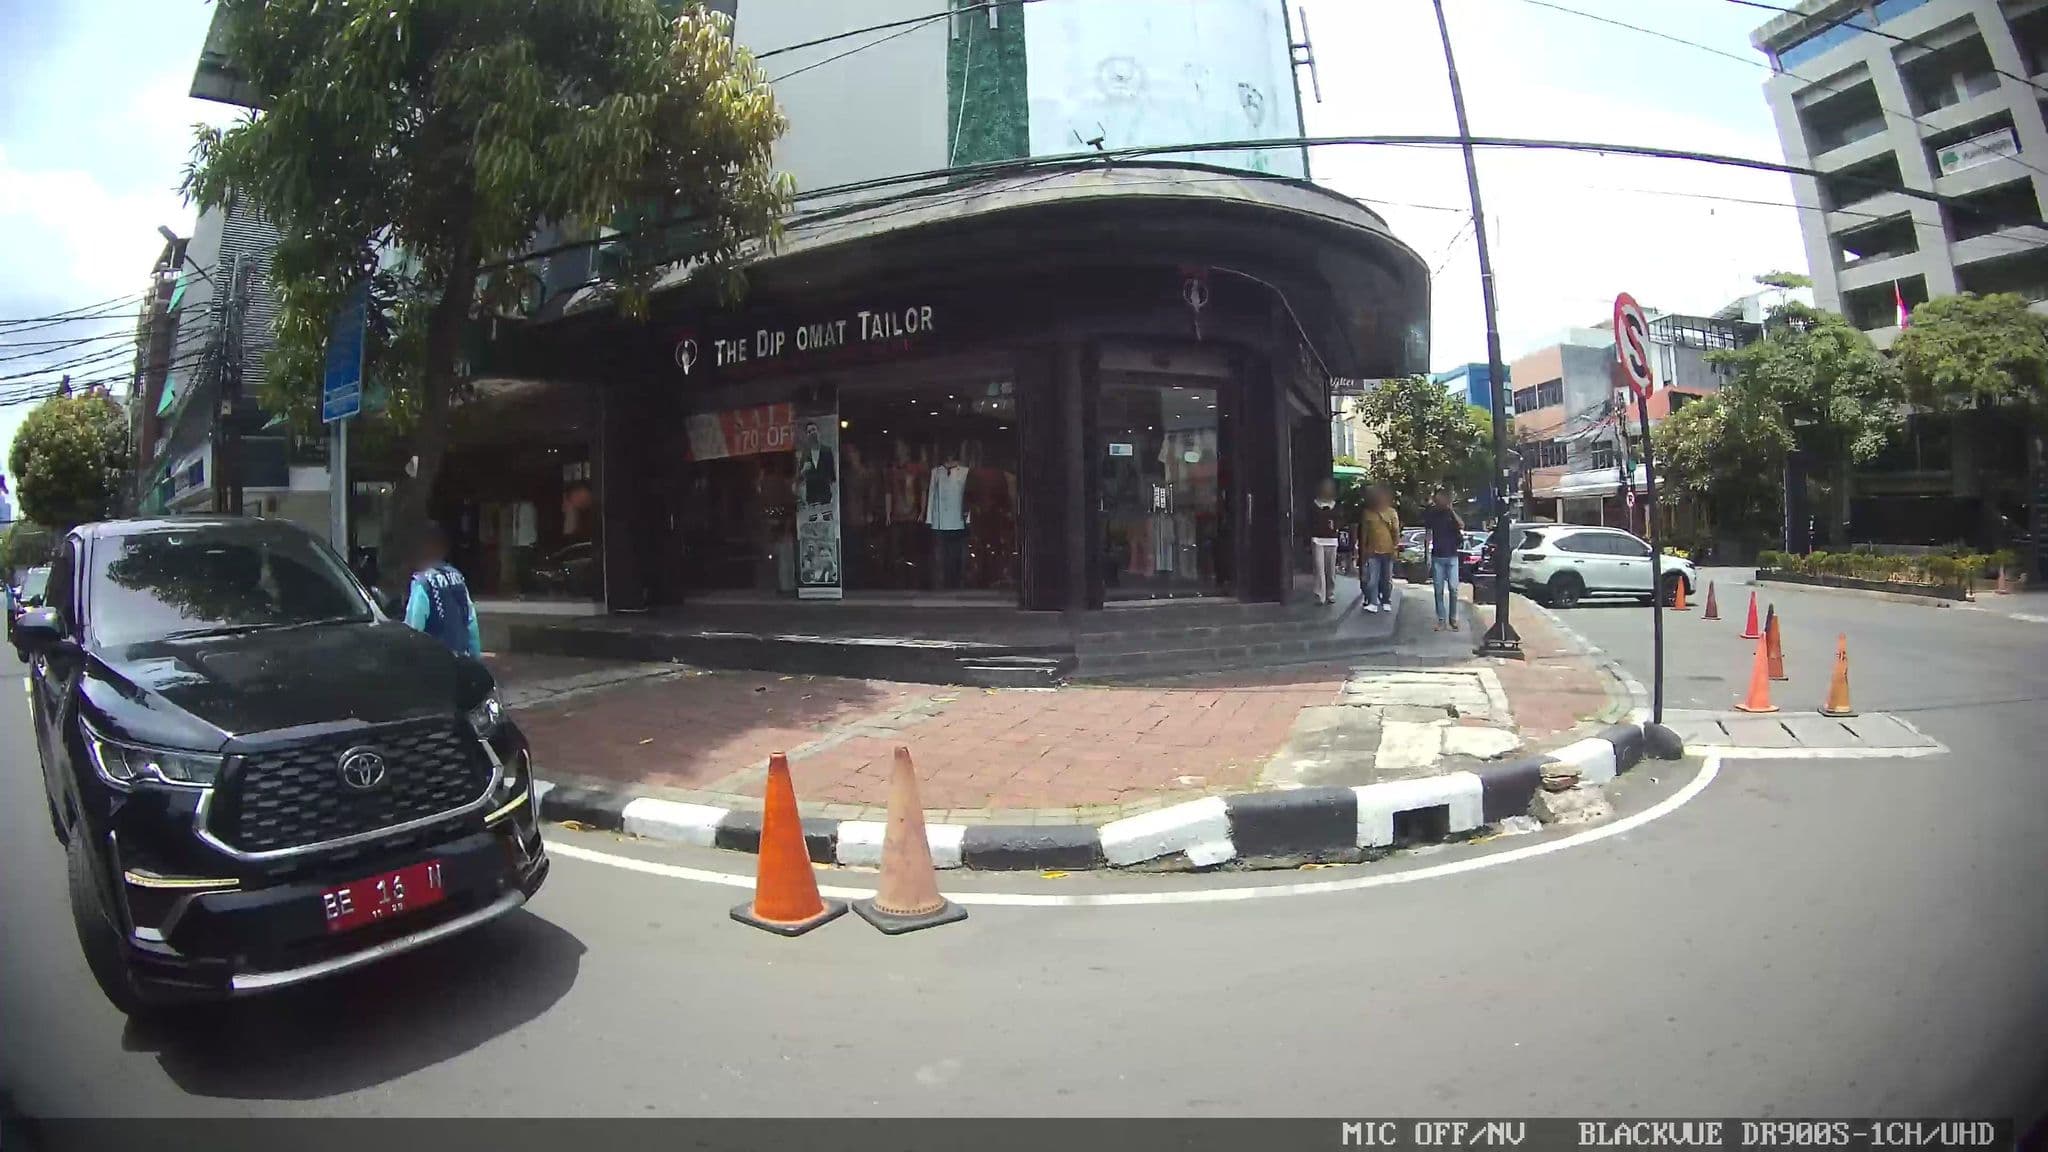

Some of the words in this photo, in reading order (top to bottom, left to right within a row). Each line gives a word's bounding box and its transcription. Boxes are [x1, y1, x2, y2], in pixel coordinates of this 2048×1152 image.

[715, 338, 748, 367] THE
[858, 305, 934, 341] TAILOR
[323, 889, 354, 919] BE
